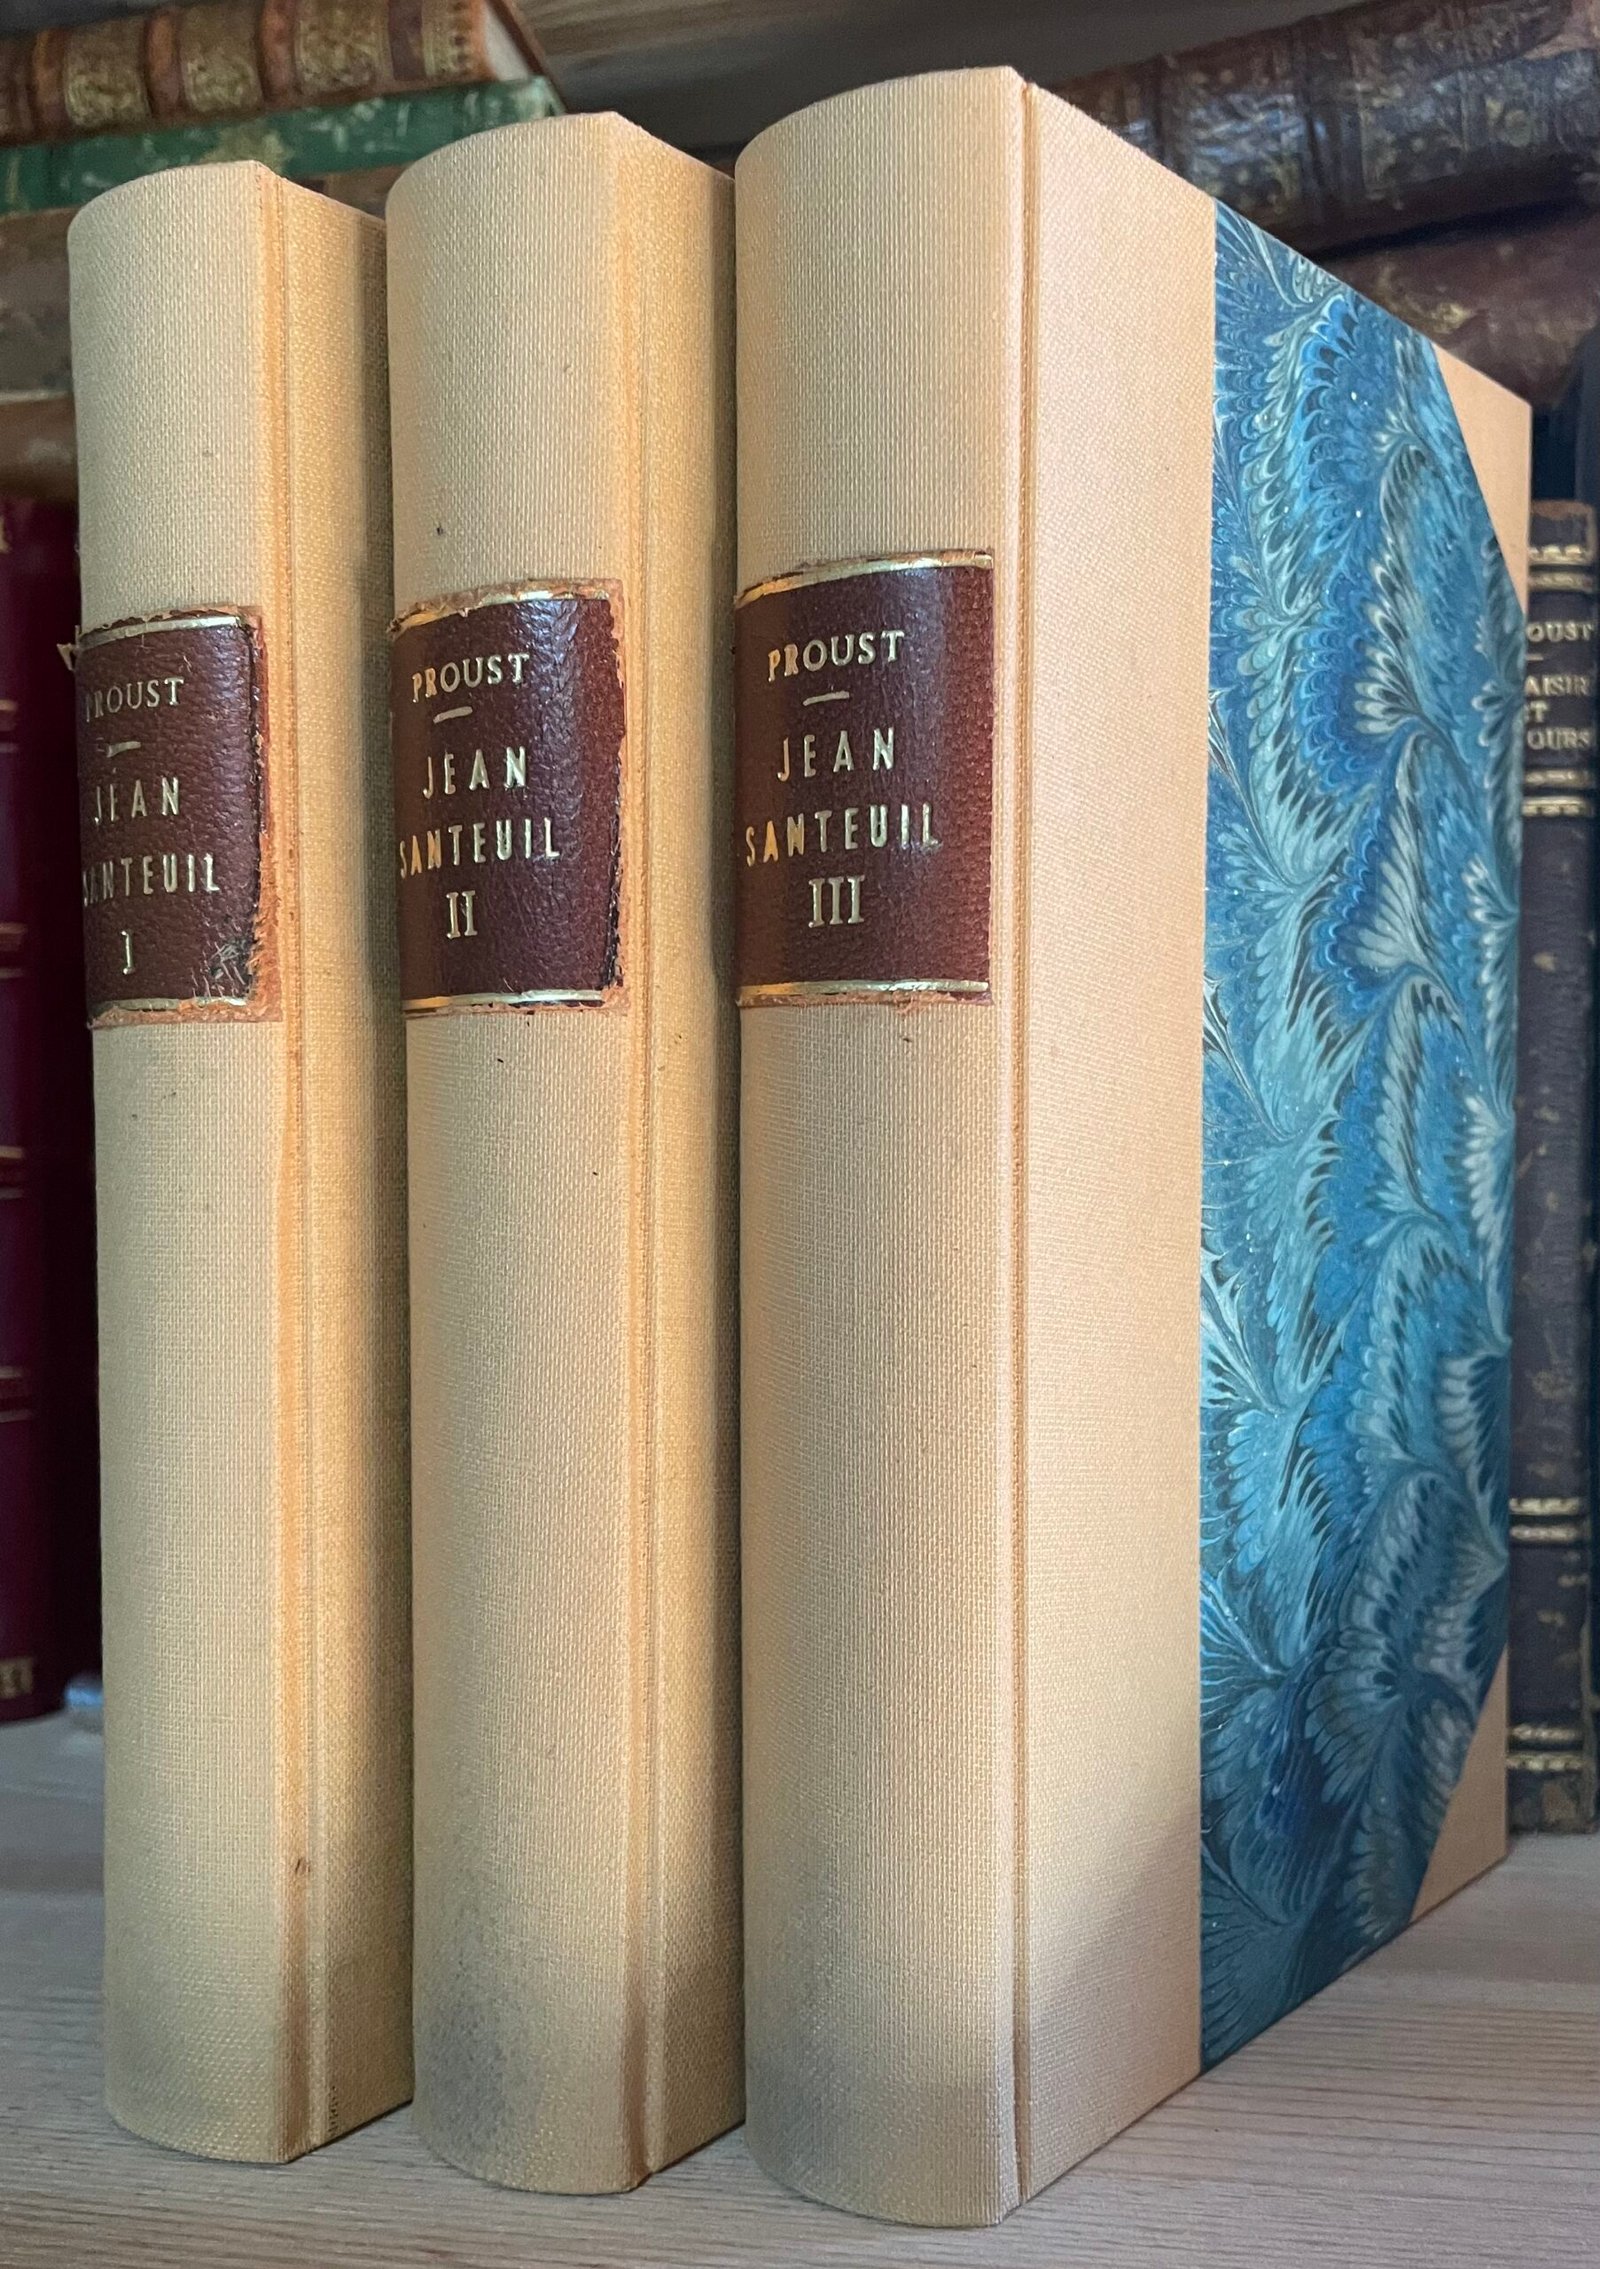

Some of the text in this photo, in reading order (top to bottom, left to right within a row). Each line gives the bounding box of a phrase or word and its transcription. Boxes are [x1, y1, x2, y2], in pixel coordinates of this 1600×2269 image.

[411, 652, 530, 704] PROUST
[768, 629, 905, 683] PROUST
[422, 745, 528, 800] JEAN
[776, 726, 896, 783] JEAN
[93, 776, 180, 826] JEAN
[399, 816, 560, 880] SANTEUIL
[744, 802, 943, 868] SANTEUIL
[445, 889, 479, 940] II
[807, 874, 865, 929] III
